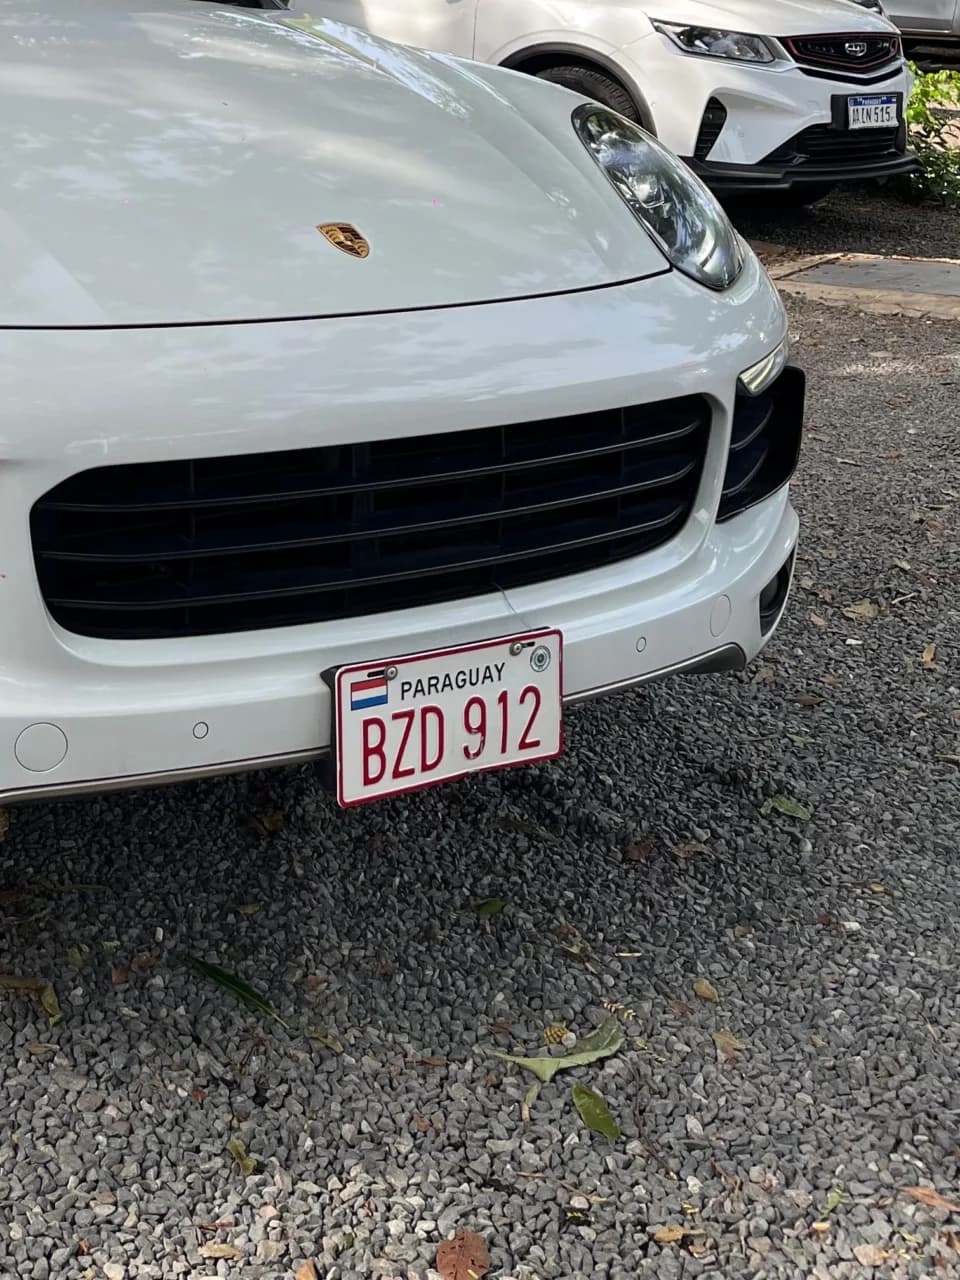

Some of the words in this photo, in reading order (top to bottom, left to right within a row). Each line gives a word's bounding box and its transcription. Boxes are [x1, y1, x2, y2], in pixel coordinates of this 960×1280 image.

[874, 106, 891, 123] 515
[400, 662, 506, 701] PARAGUAY
[362, 704, 445, 787] BZD
[462, 685, 542, 761] 912
